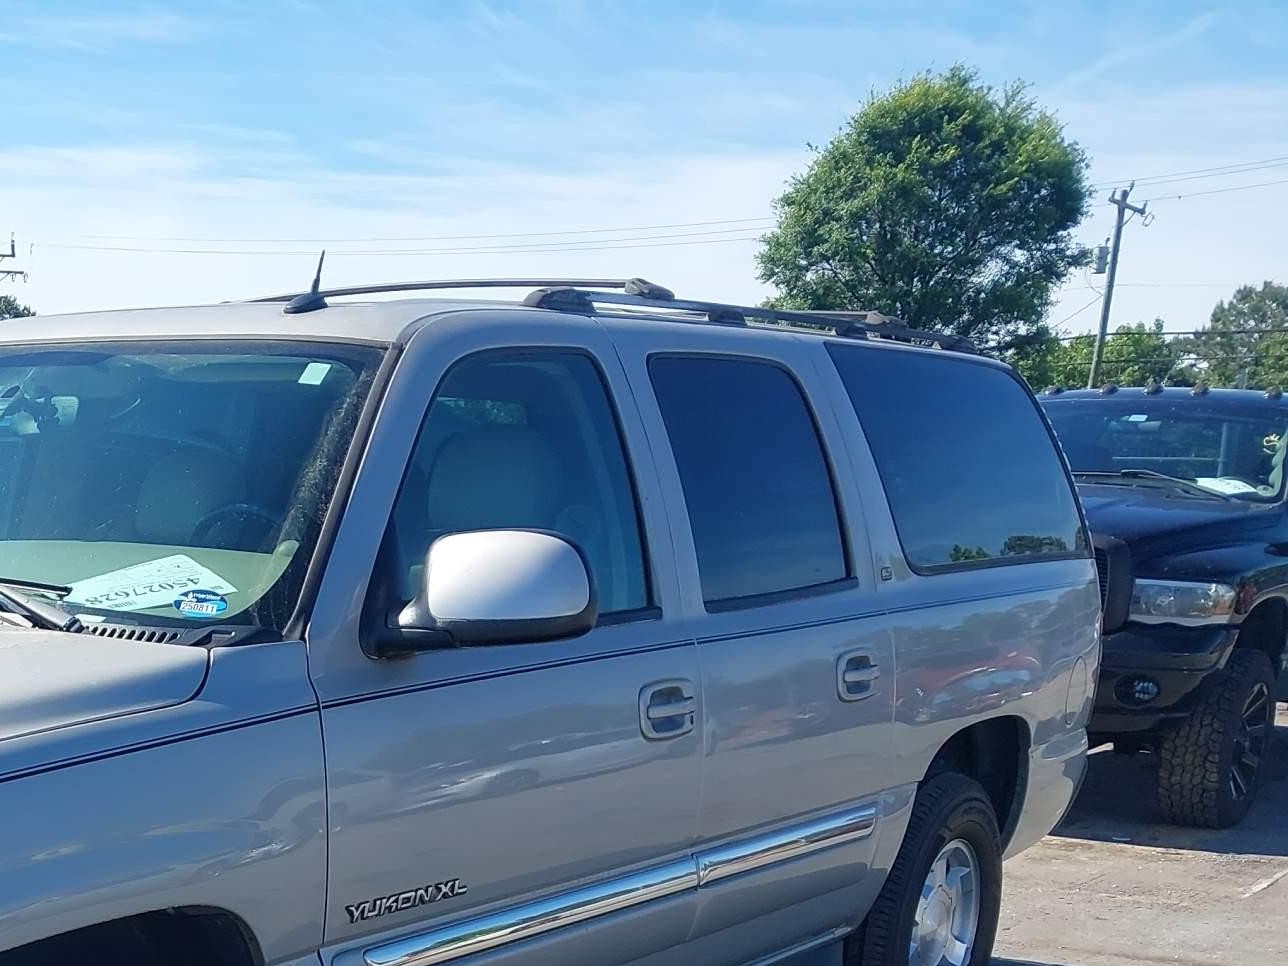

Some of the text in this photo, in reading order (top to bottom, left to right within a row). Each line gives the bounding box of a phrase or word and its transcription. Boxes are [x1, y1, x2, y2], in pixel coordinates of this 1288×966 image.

[85, 576, 201, 606] 45027628
[181, 602, 215, 613] 250811
[345, 878, 469, 923] YUKON XL
